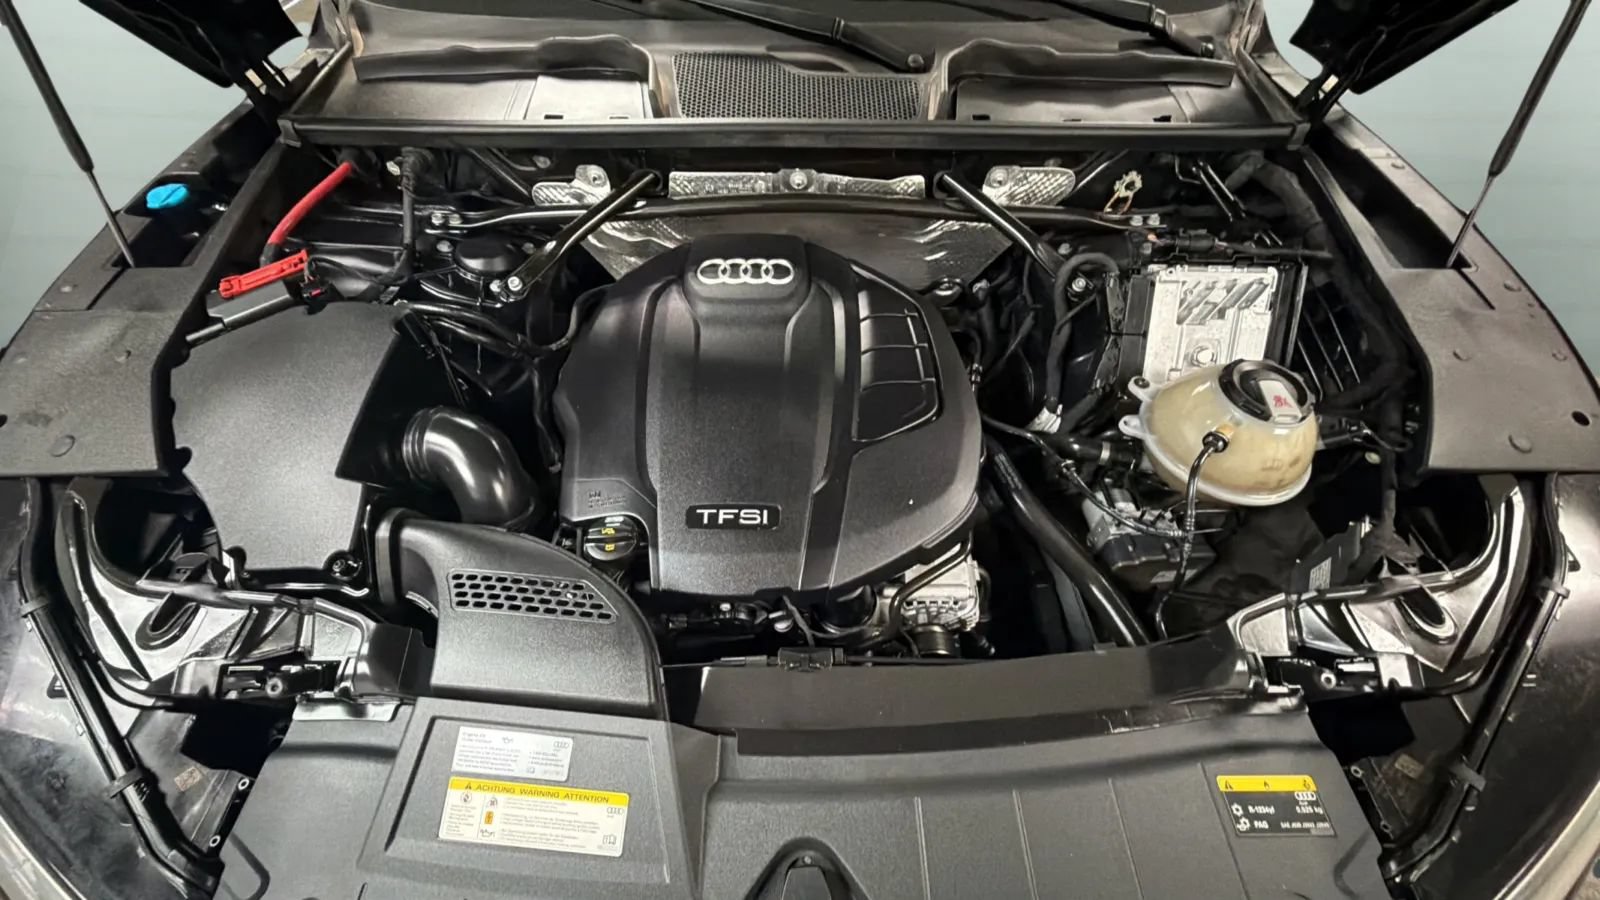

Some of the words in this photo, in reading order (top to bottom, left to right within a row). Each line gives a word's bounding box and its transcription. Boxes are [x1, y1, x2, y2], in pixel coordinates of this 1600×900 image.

[696, 508, 768, 525] TFSI
[475, 783, 515, 794] ACHTUNG
[519, 788, 560, 799] WARNING
[564, 792, 610, 804] ATTENTION
